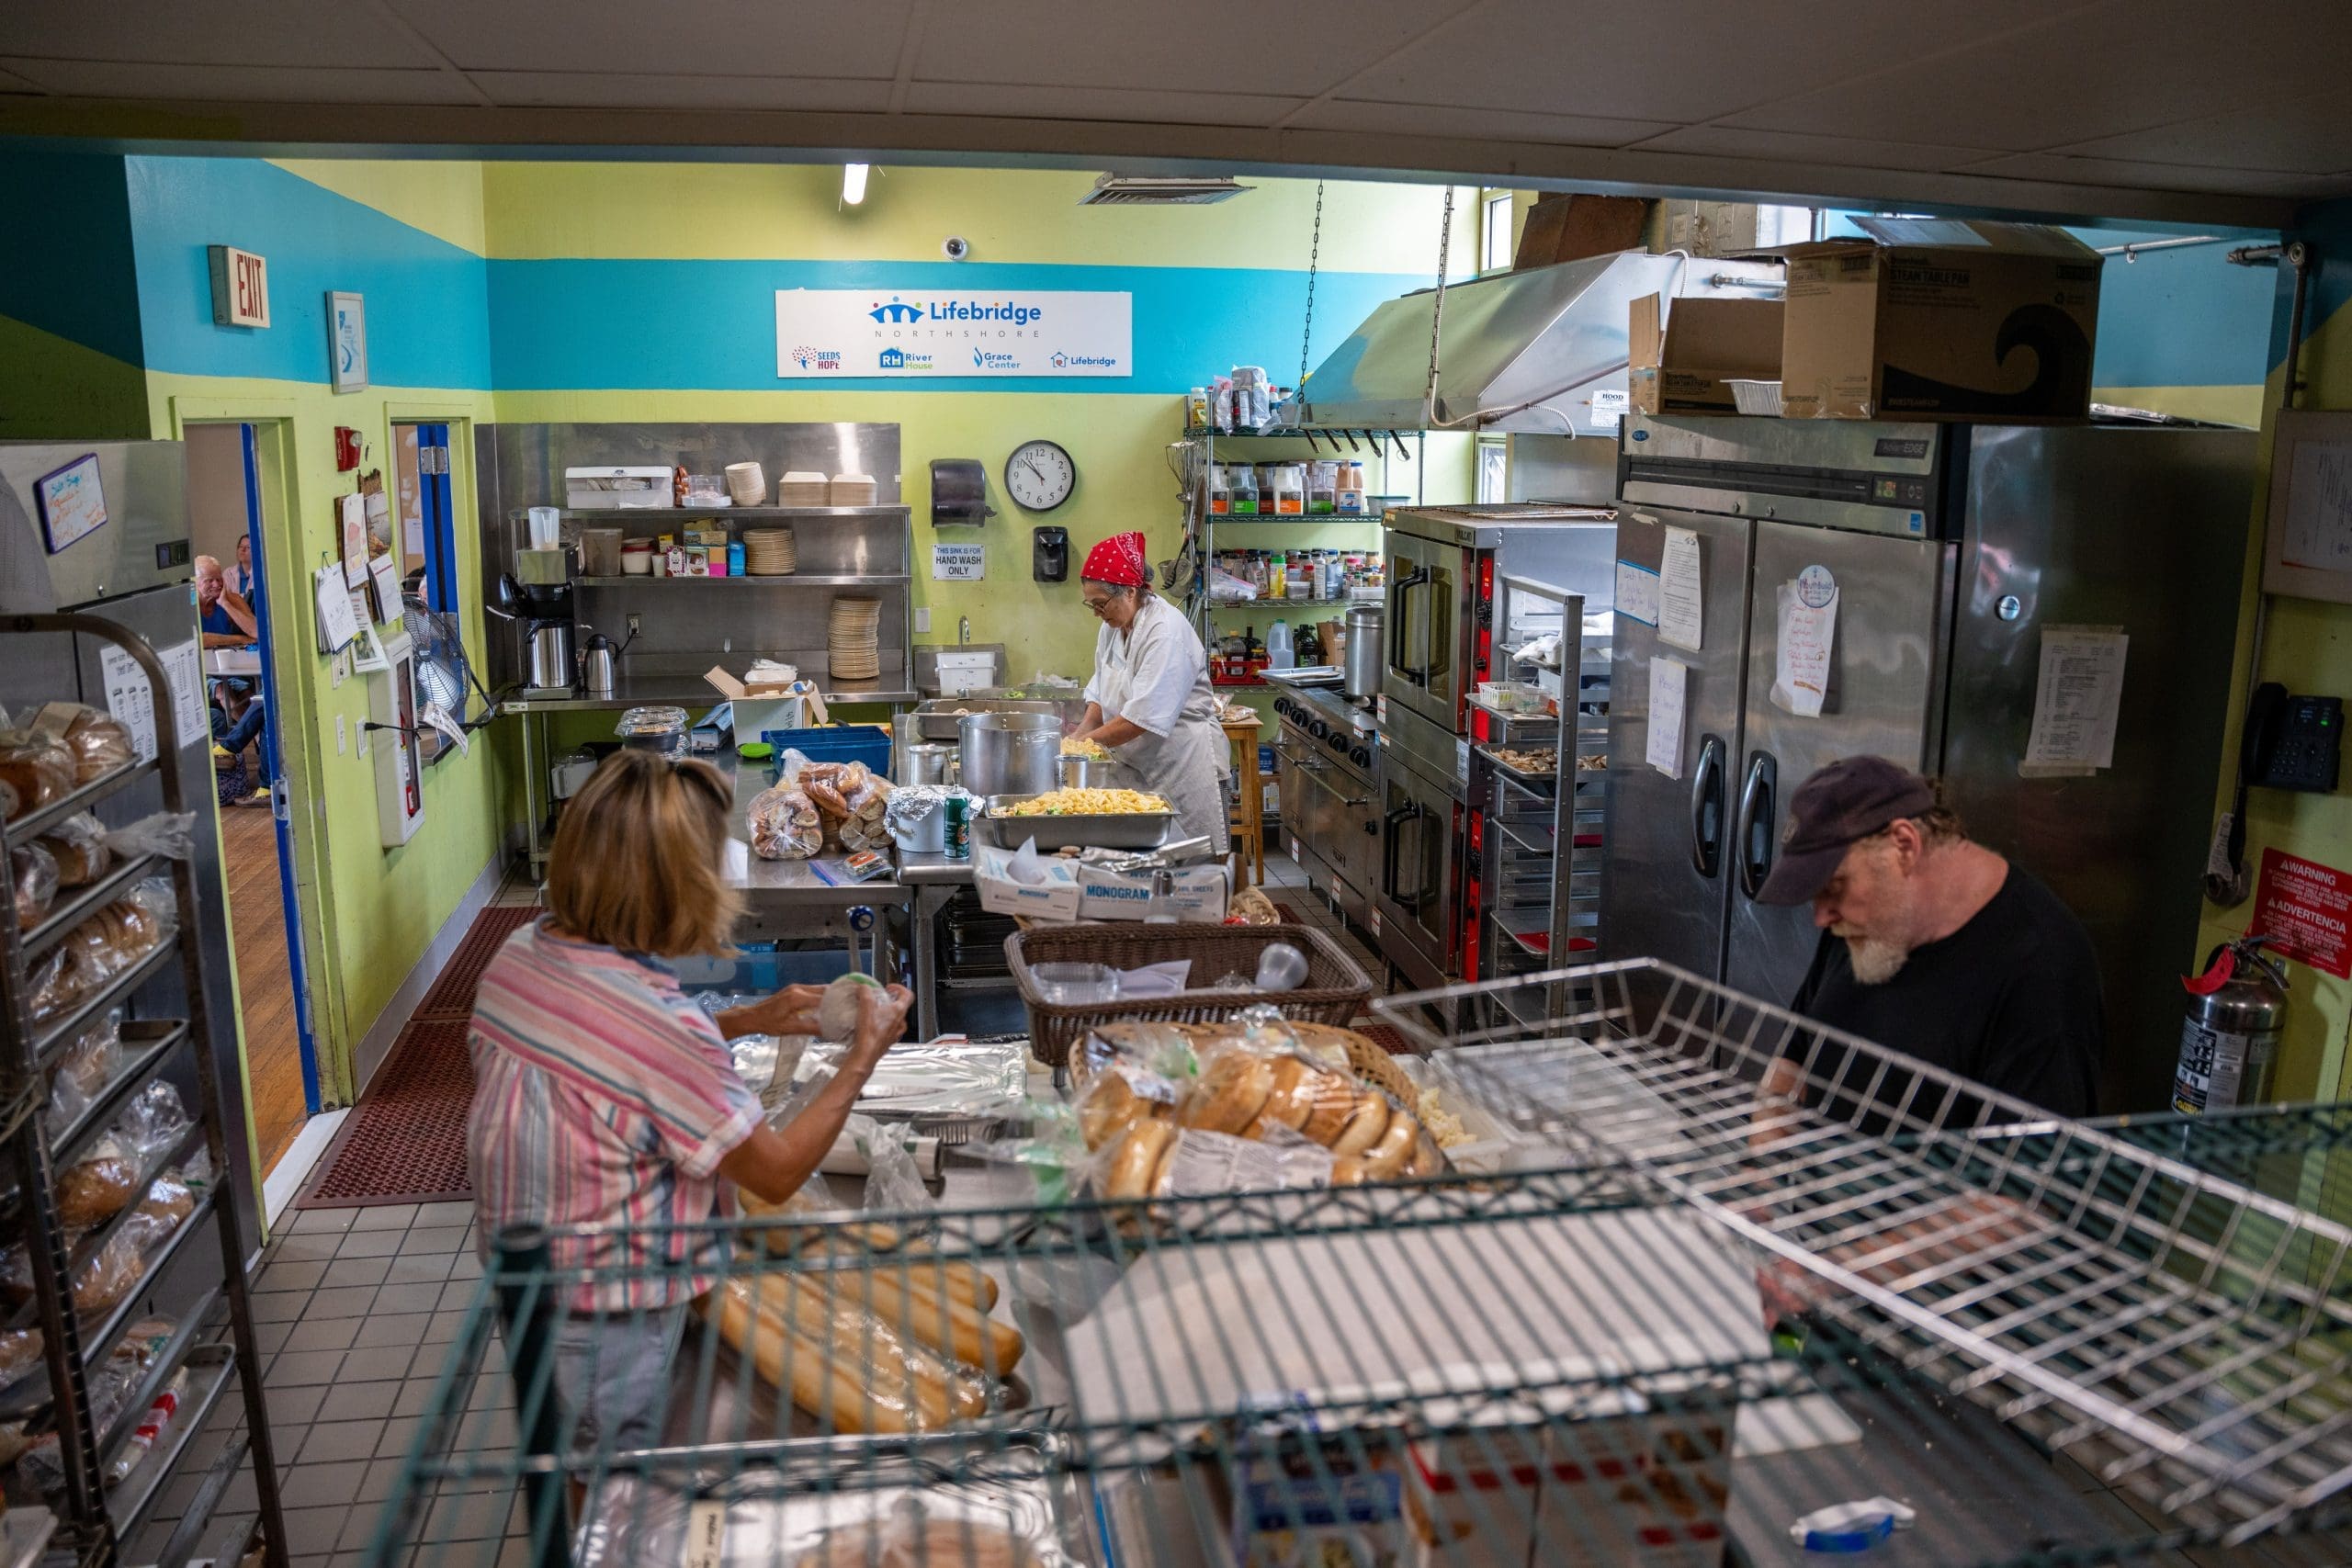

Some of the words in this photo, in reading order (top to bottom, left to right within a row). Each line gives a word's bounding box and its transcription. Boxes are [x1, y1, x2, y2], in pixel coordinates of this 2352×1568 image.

[237, 254, 264, 321] EXIT
[930, 300, 1042, 326] Lifebridge
[875, 330, 1039, 338] NORTHSHORE
[817, 352, 842, 360] SEEDS
[883, 355, 902, 366] RH
[905, 354, 933, 362] River
[984, 353, 1012, 361] Grace
[818, 361, 840, 369] HOPE
[988, 360, 1021, 369] Center
[1070, 356, 1116, 367] Lifebridge
[1025, 452, 1033, 460] 11
[1036, 448, 1046, 457] 12
[1051, 452, 1055, 460] 1
[1016, 460, 1025, 468] 10
[1058, 460, 1063, 469] 2
[1013, 471, 1019, 479] 9
[1061, 472, 1067, 480] 3
[1016, 484, 1022, 492] 8
[1026, 492, 1031, 501] 7
[1036, 495, 1043, 504] 6
[1049, 492, 1055, 501] 5
[936, 556, 957, 565] HAND
[959, 556, 982, 565] WASH
[948, 566, 969, 575] ONLY
[2288, 861, 2336, 886] WARNING
[1087, 885, 1149, 900] MONOGRAM
[2277, 899, 2346, 934] ADVERTENCIA
